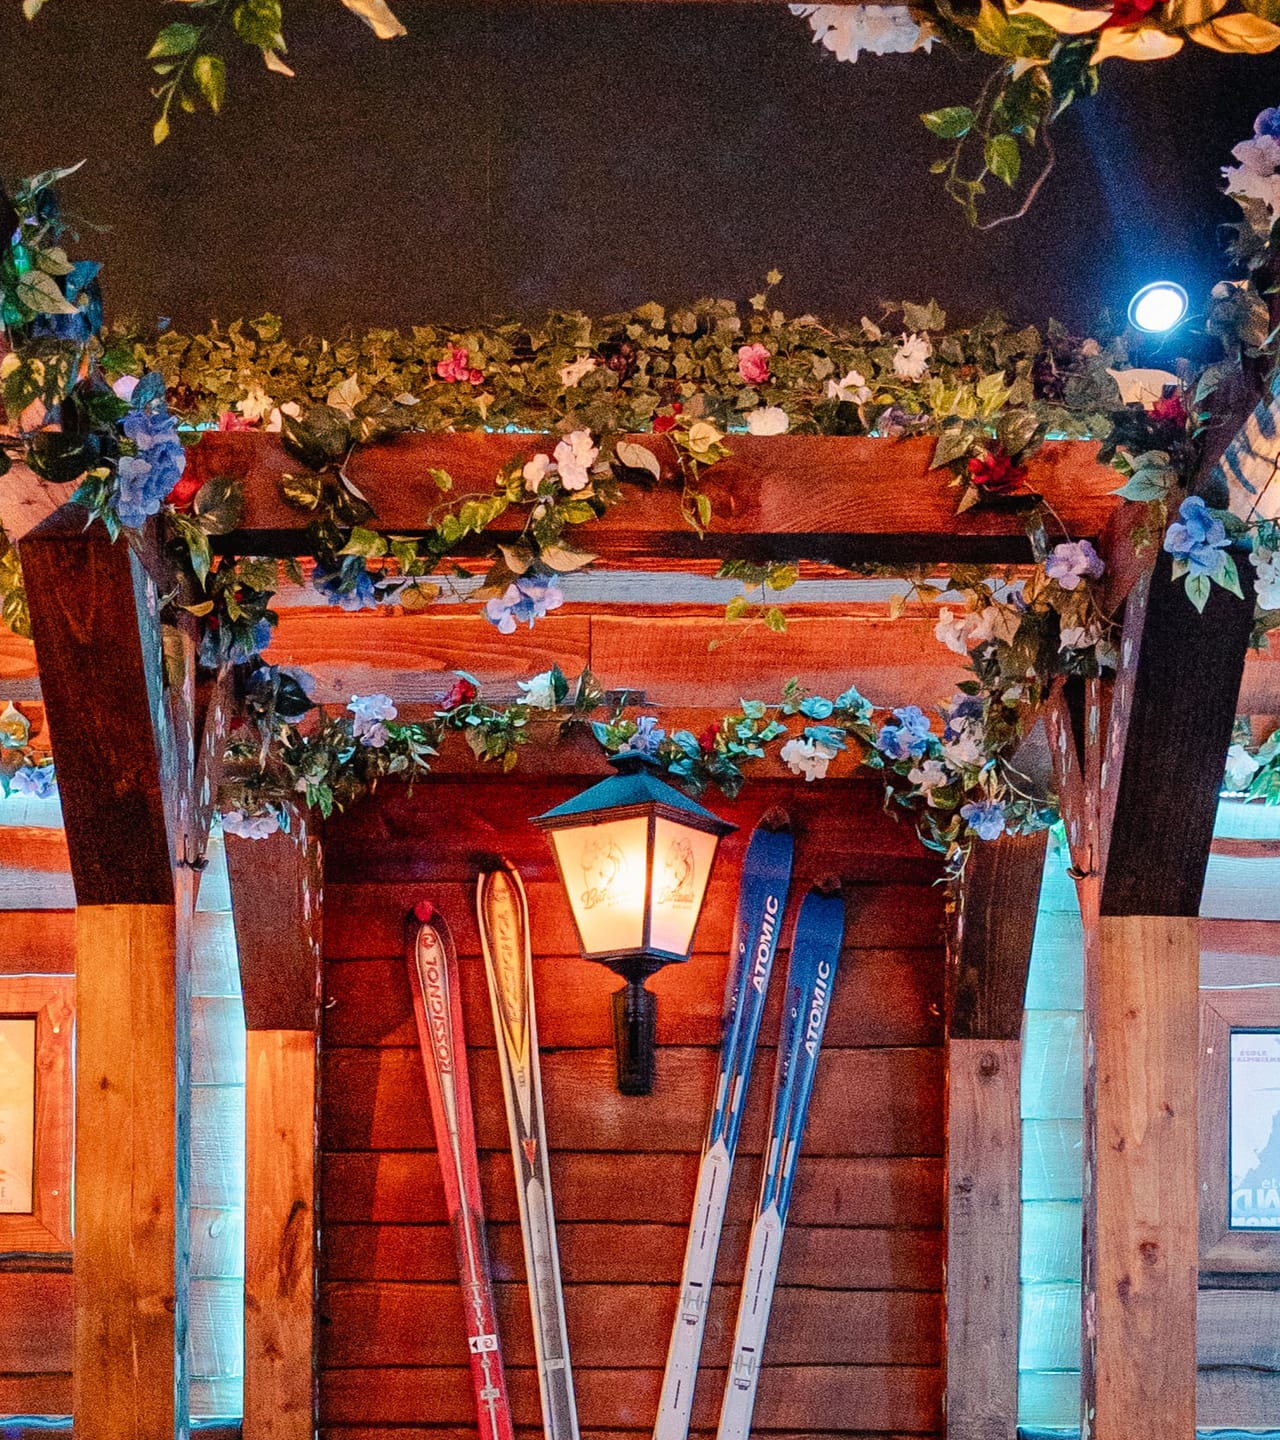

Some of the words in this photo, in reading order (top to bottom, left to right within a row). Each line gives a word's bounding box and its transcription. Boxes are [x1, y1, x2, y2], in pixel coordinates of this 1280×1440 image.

[753, 895, 779, 994] ATOMIC
[425, 957, 452, 1074] ROSSIGNOL
[805, 961, 830, 1059] ATOMIC
